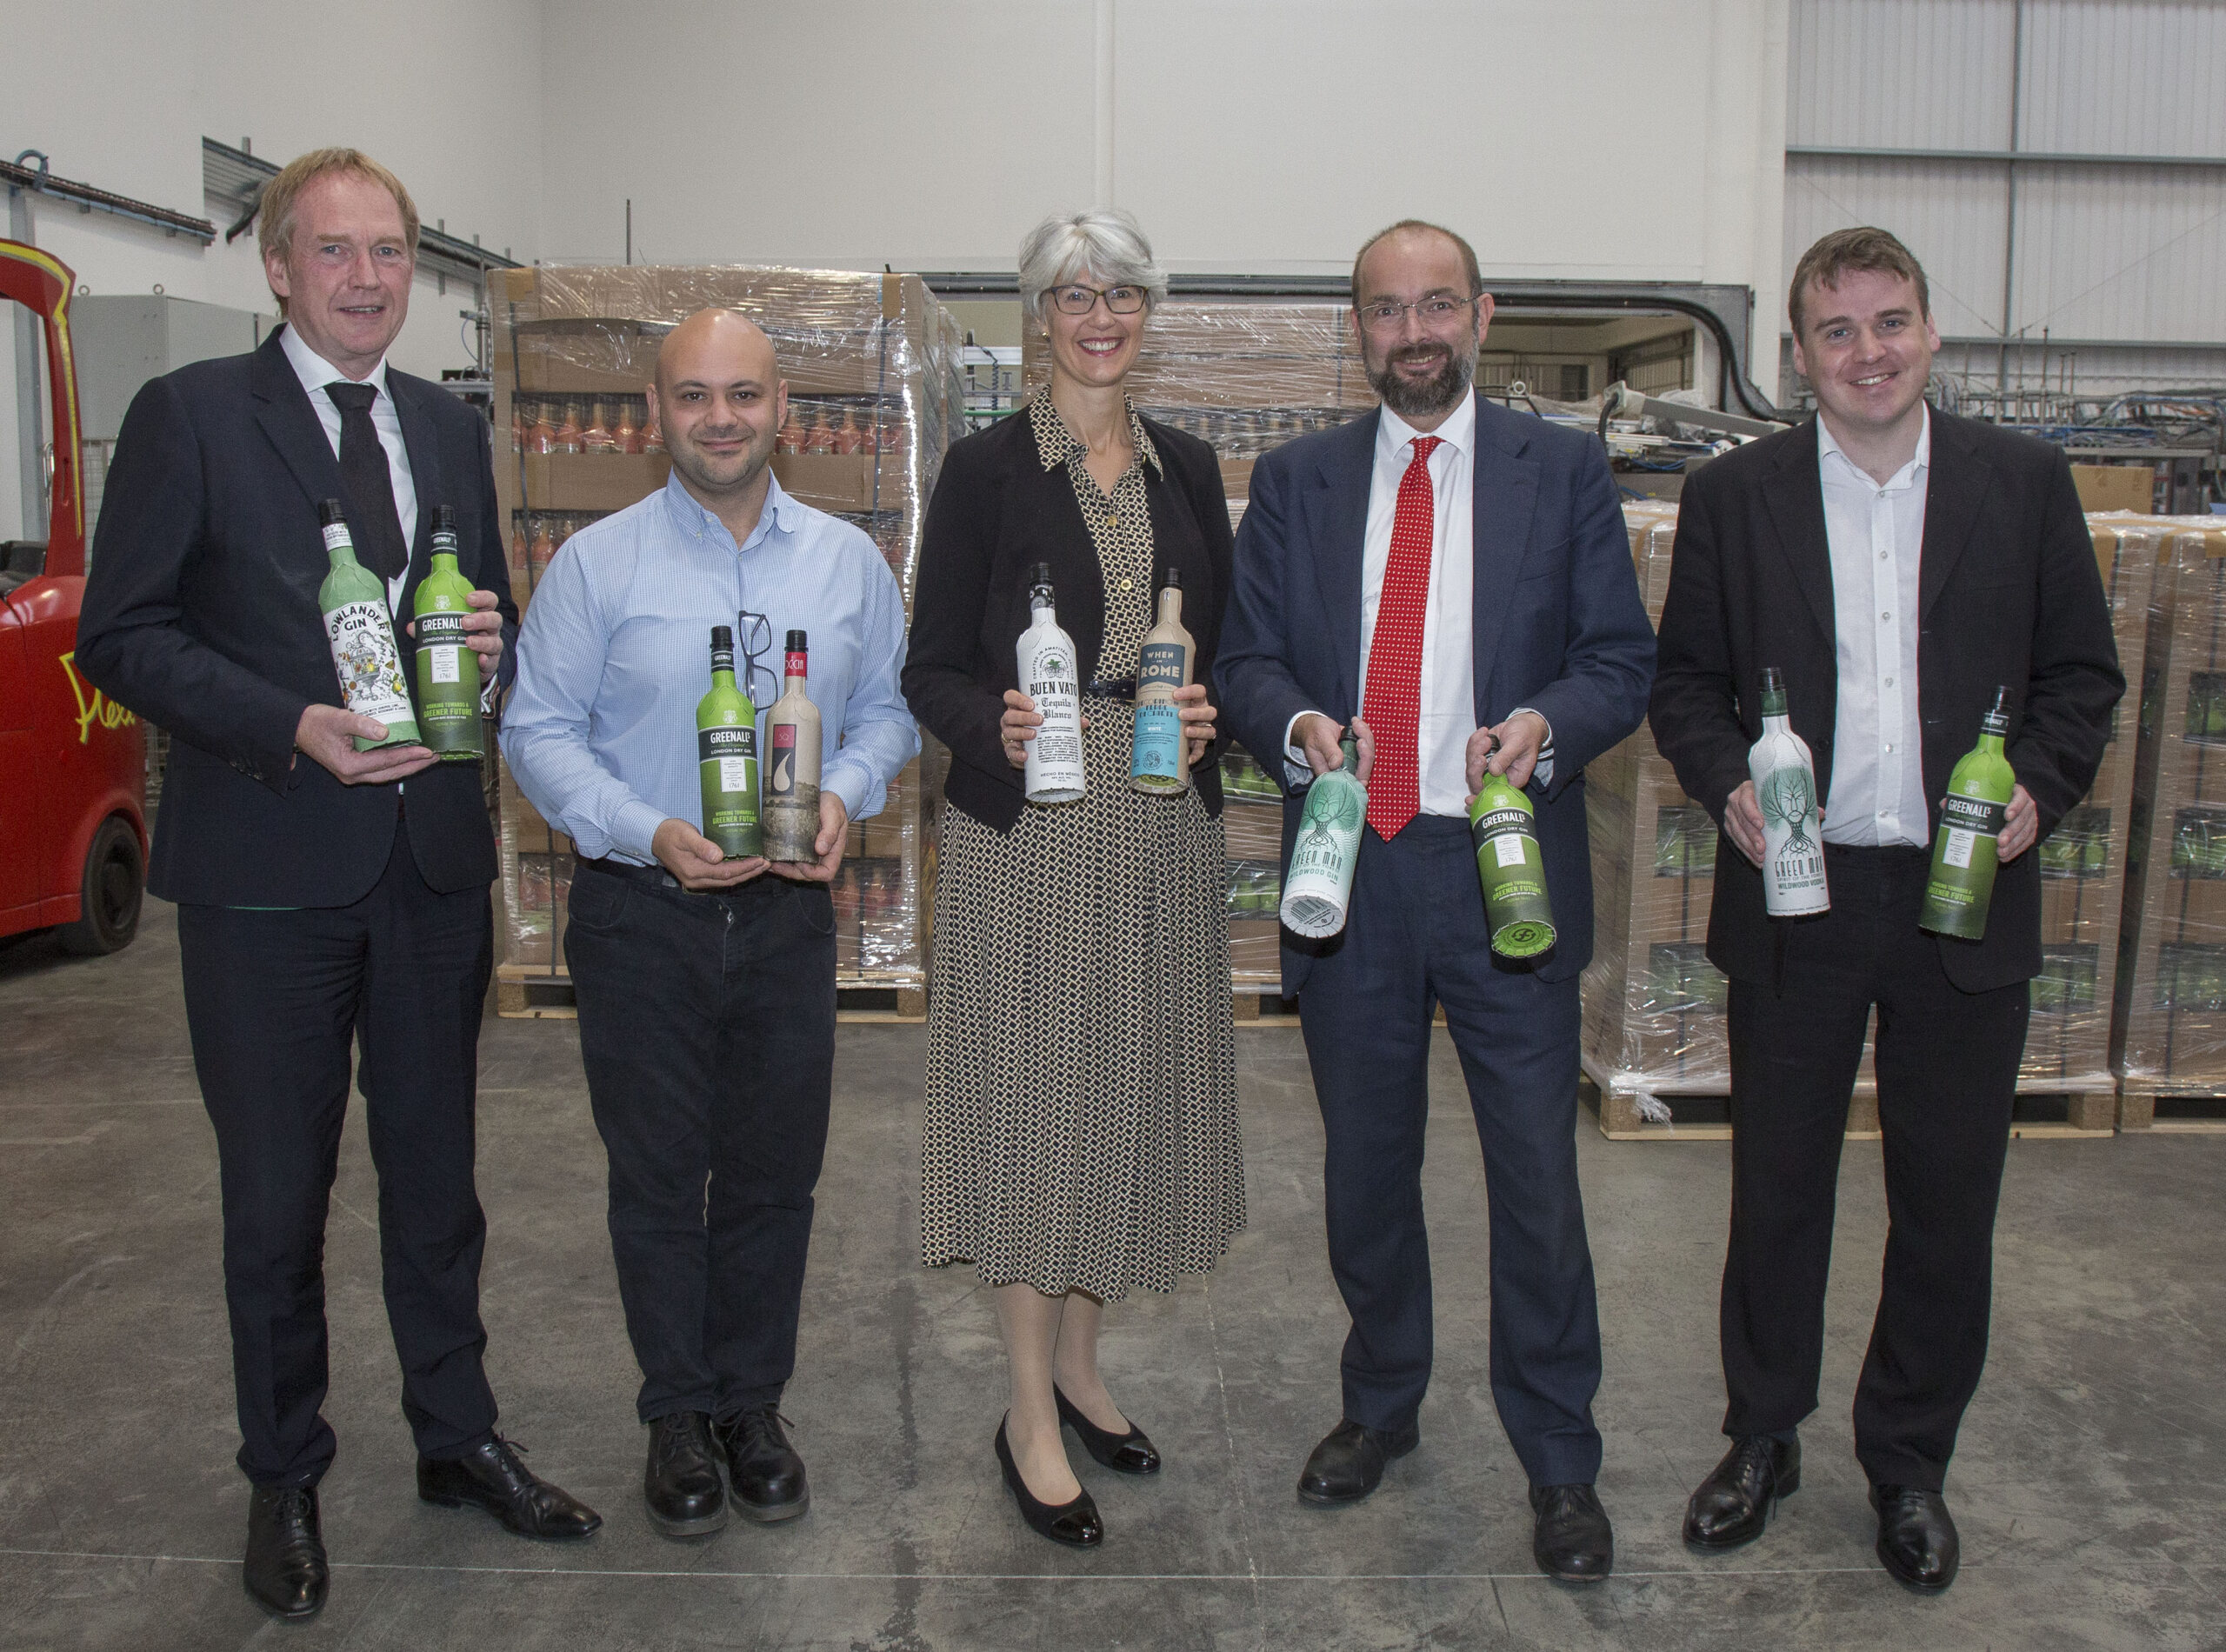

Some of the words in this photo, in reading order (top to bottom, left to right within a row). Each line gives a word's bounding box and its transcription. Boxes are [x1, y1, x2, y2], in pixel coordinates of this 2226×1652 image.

[331, 605, 385, 642] LOWLANDER
[344, 617, 367, 630] GIN
[422, 617, 463, 632] GREENALL
[1141, 664, 1180, 679] ROME
[1030, 682, 1056, 696] BUEN
[1057, 682, 1077, 696] VATO
[1041, 697, 1071, 709] Tequila
[1042, 709, 1072, 719] Blanco
[1483, 827, 1506, 839] LONDON
[1775, 859, 1804, 877] GREEN
[1327, 871, 1338, 882] GIN
[1777, 881, 1809, 889] WILDWOOD
